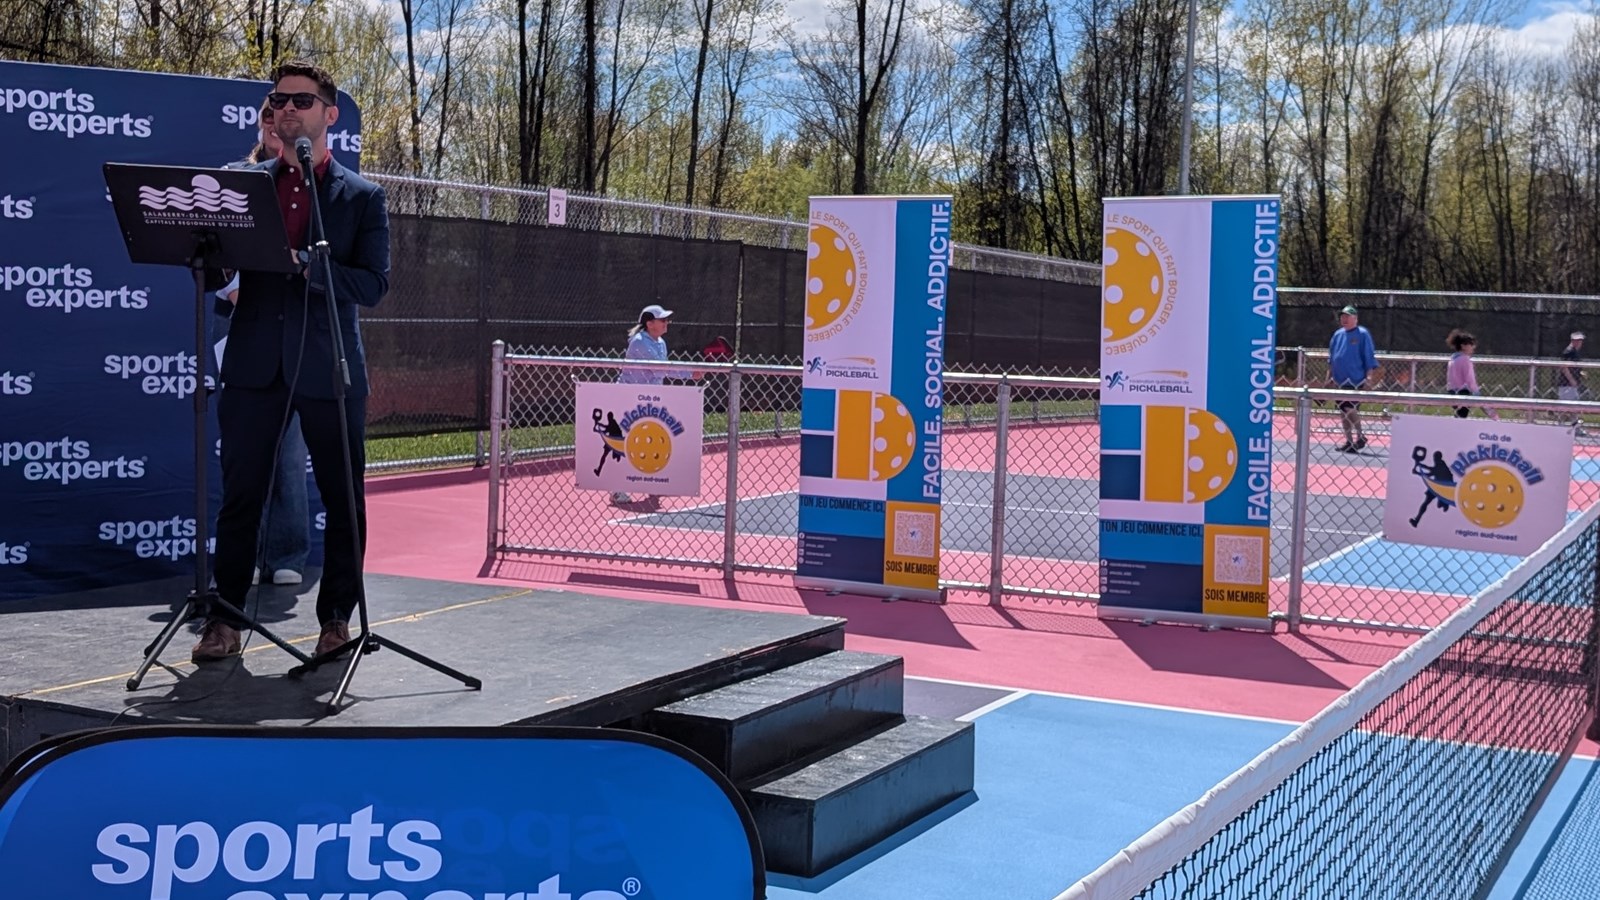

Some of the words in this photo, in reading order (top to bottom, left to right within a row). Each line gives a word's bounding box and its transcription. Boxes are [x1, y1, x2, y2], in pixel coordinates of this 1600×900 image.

[142, 211, 254, 220] SALABERRY-DE-VALLEYFIELD
[554, 203, 561, 218] 3
[811, 211, 821, 220] LE
[1107, 214, 1120, 223] LE
[823, 212, 850, 234] SPORT
[1121, 215, 1155, 237] SPORT
[848, 232, 862, 250] QUI
[1152, 235, 1169, 255] QUI
[856, 250, 868, 270] FAIT
[927, 201, 951, 311] ADDICTIF.
[1163, 255, 1177, 276] FAIT
[1252, 201, 1277, 319] ADDICTIF.
[850, 273, 868, 315] BOUGER
[1157, 280, 1178, 325] BOUGER
[842, 314, 854, 327] LE
[1147, 324, 1161, 337] LE
[1105, 334, 1149, 356] QUÉBEC
[103, 350, 198, 379] sports
[925, 316, 943, 409] SOCIAL.
[826, 369, 879, 379] PICKLEBALL
[1249, 325, 1273, 425] SOCIAL.
[637, 394, 652, 402] Club
[1129, 384, 1193, 394] PICKLEBALL
[620, 403, 685, 437] pickleball
[1478, 432, 1499, 442] Club
[1499, 434, 1512, 443] de
[0, 436, 90, 466] ports
[923, 415, 941, 498] FACILE.
[1450, 444, 1545, 486] pickleball
[1247, 431, 1270, 521] FACILE.
[800, 495, 814, 507] TON
[815, 496, 828, 508] JEU
[829, 498, 872, 511] COMMENCE
[98, 515, 197, 545] sports
[1100, 520, 1118, 532] TON
[1119, 522, 1136, 533] JEU
[1137, 523, 1187, 537] COMMENCE
[1480, 530, 1518, 542] sud-ouest
[885, 560, 903, 573] SOIS
[904, 562, 938, 576] MEMBRE
[1205, 588, 1225, 602] SOIS
[1226, 590, 1267, 604] MEMBRE
[92, 803, 443, 900] sports
